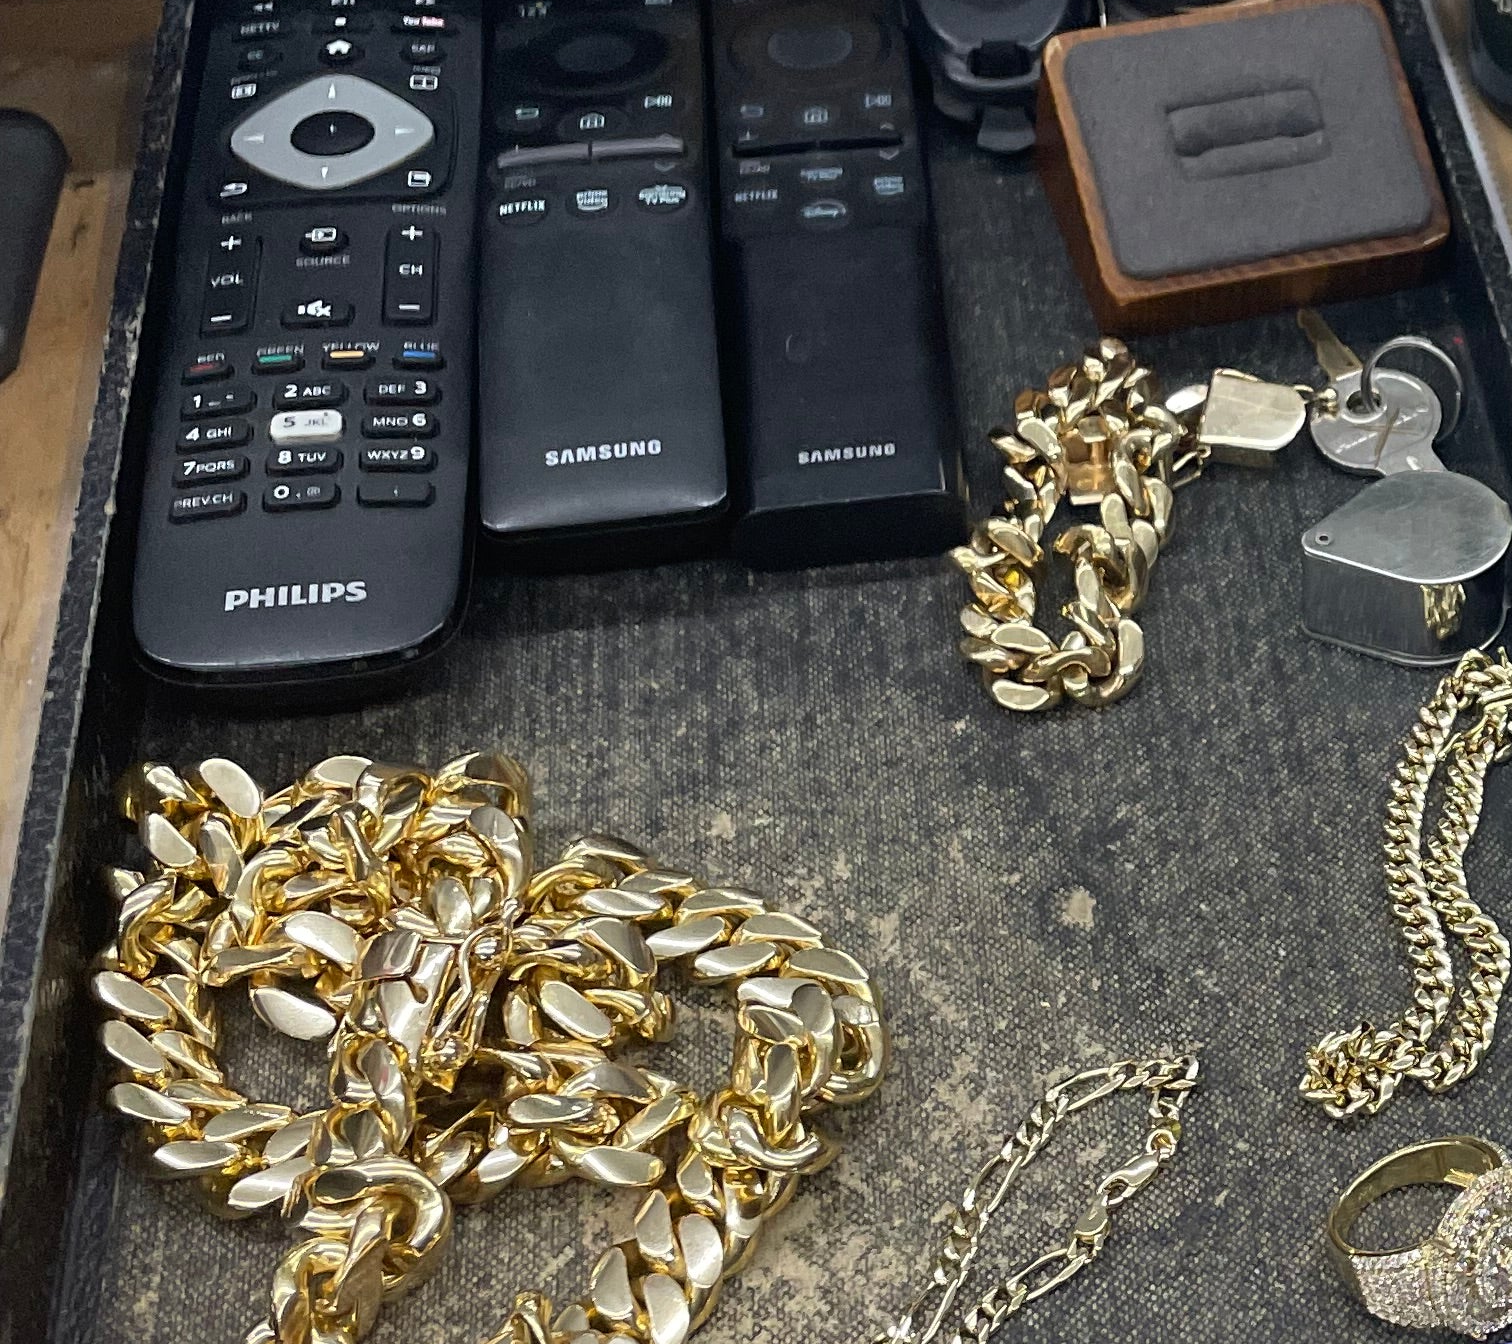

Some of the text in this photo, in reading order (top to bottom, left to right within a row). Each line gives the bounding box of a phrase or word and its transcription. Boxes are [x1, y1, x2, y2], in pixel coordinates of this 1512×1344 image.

[499, 200, 546, 216] NETFLIX
[399, 263, 423, 276] CH
[210, 272, 243, 289] VOL
[284, 384, 332, 398] 2 ABC
[414, 381, 427, 395] 3
[193, 395, 202, 409] 1
[283, 417, 296, 428] 5
[373, 413, 427, 428] MNO 6
[185, 427, 232, 441] 4 GHI
[278, 450, 327, 465] 8 TUV
[368, 446, 425, 461] WXYZ 9
[545, 439, 662, 468] SAMSUNG
[798, 442, 896, 465] SAMSUNG
[224, 580, 367, 611] PHILIPS
